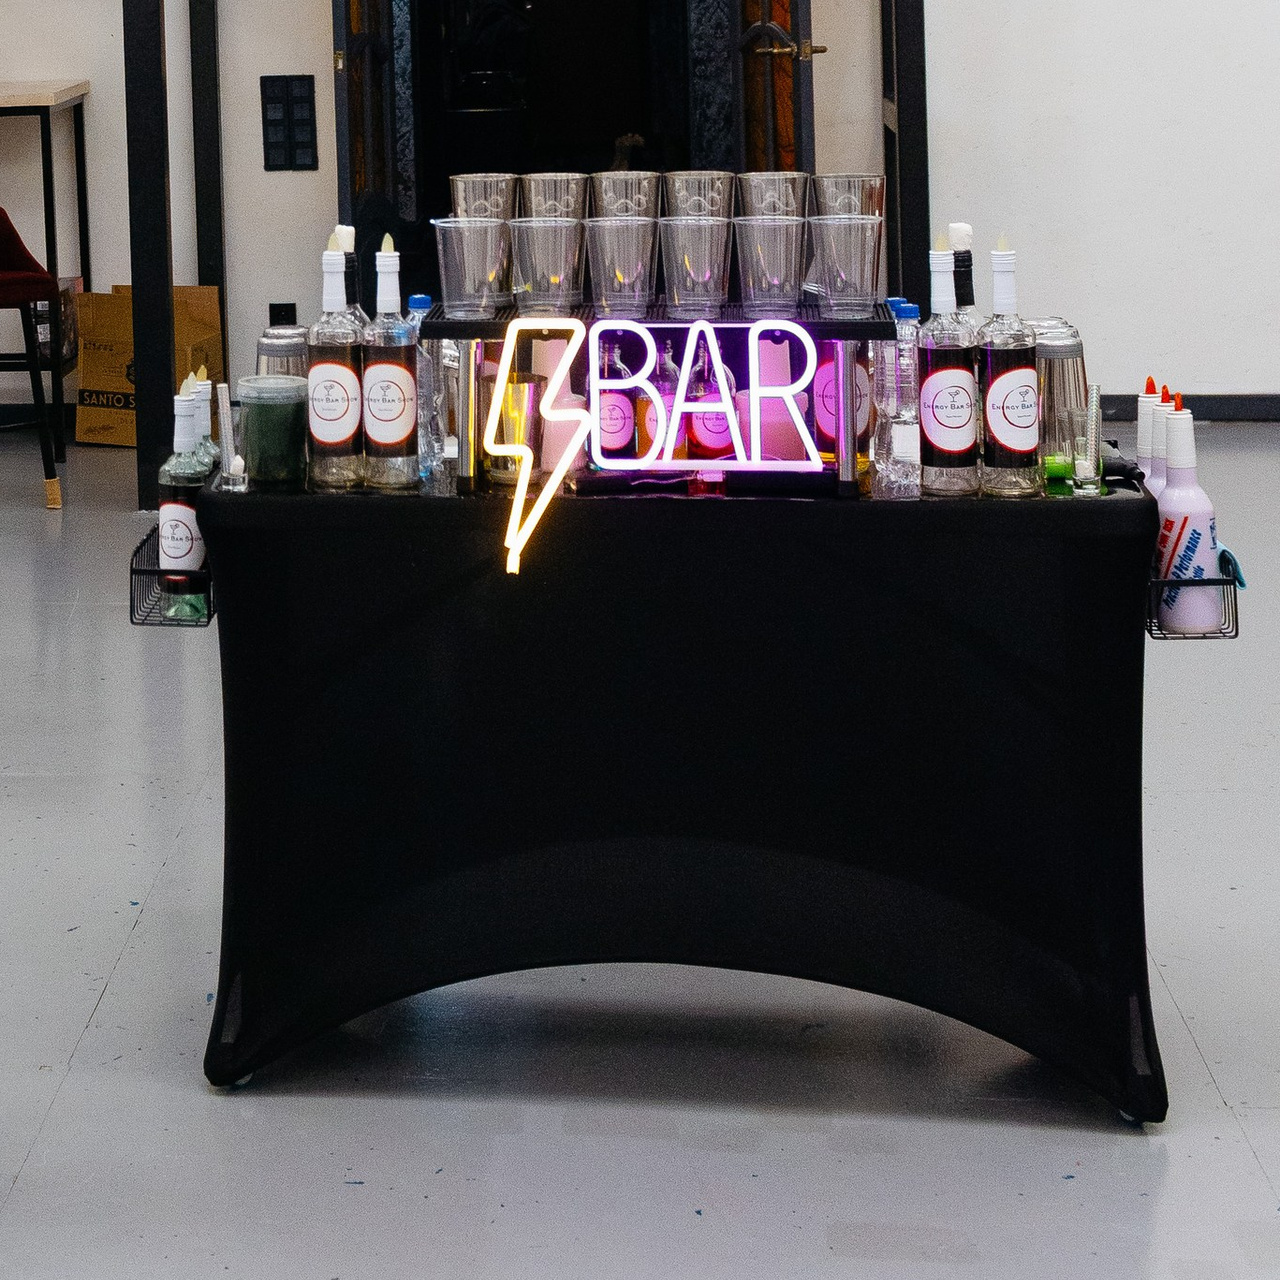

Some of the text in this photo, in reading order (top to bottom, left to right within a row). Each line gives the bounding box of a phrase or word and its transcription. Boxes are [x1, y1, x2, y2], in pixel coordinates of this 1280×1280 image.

[83, 392, 125, 407] SANTO
[589, 319, 823, 471] BAR
[1173, 528, 1202, 576] Performance
